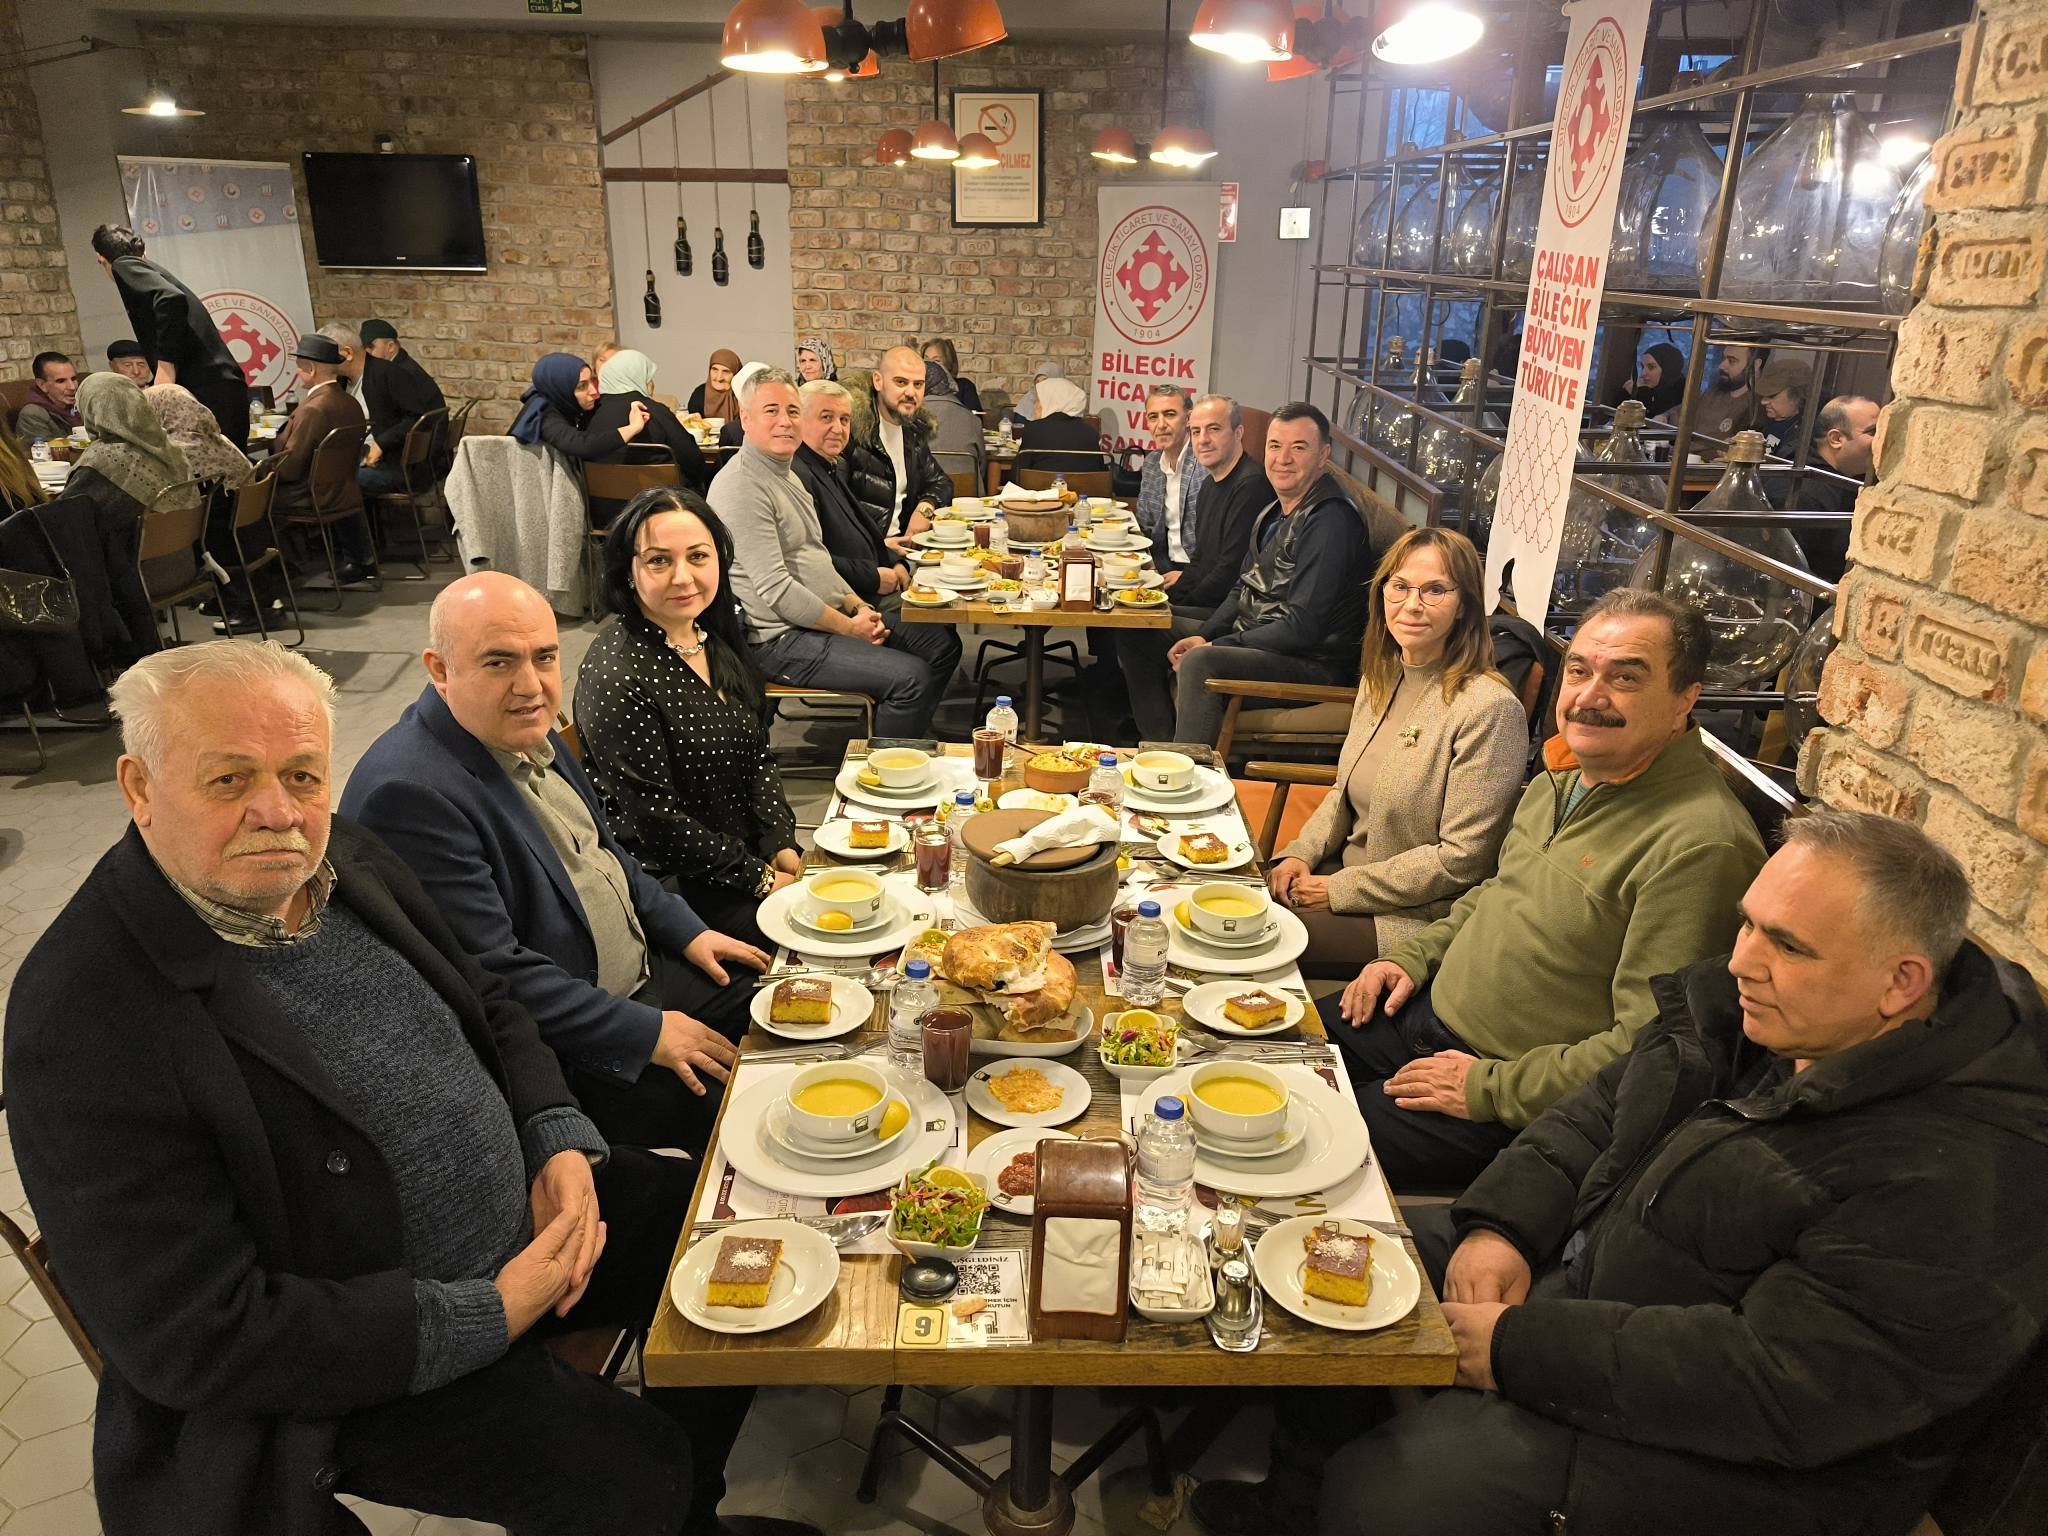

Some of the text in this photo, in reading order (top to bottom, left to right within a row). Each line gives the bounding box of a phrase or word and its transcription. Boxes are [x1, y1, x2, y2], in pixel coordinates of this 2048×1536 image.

[1565, 203, 1580, 218] 1904
[1156, 214, 1170, 224] VE
[1193, 254, 1204, 293] ODASI
[1536, 249, 1600, 292] ÇALIŞAN
[231, 298, 247, 308] VE
[1530, 281, 1592, 330] BİLECİK
[1133, 328, 1161, 340] 1904
[1525, 319, 1585, 370] BÜYÜYEN
[1102, 349, 1195, 379] BİLECİK
[1097, 375, 1197, 403] TİCAT
[1520, 356, 1579, 410] TÜRKİYE
[914, 1316, 932, 1337] 9
